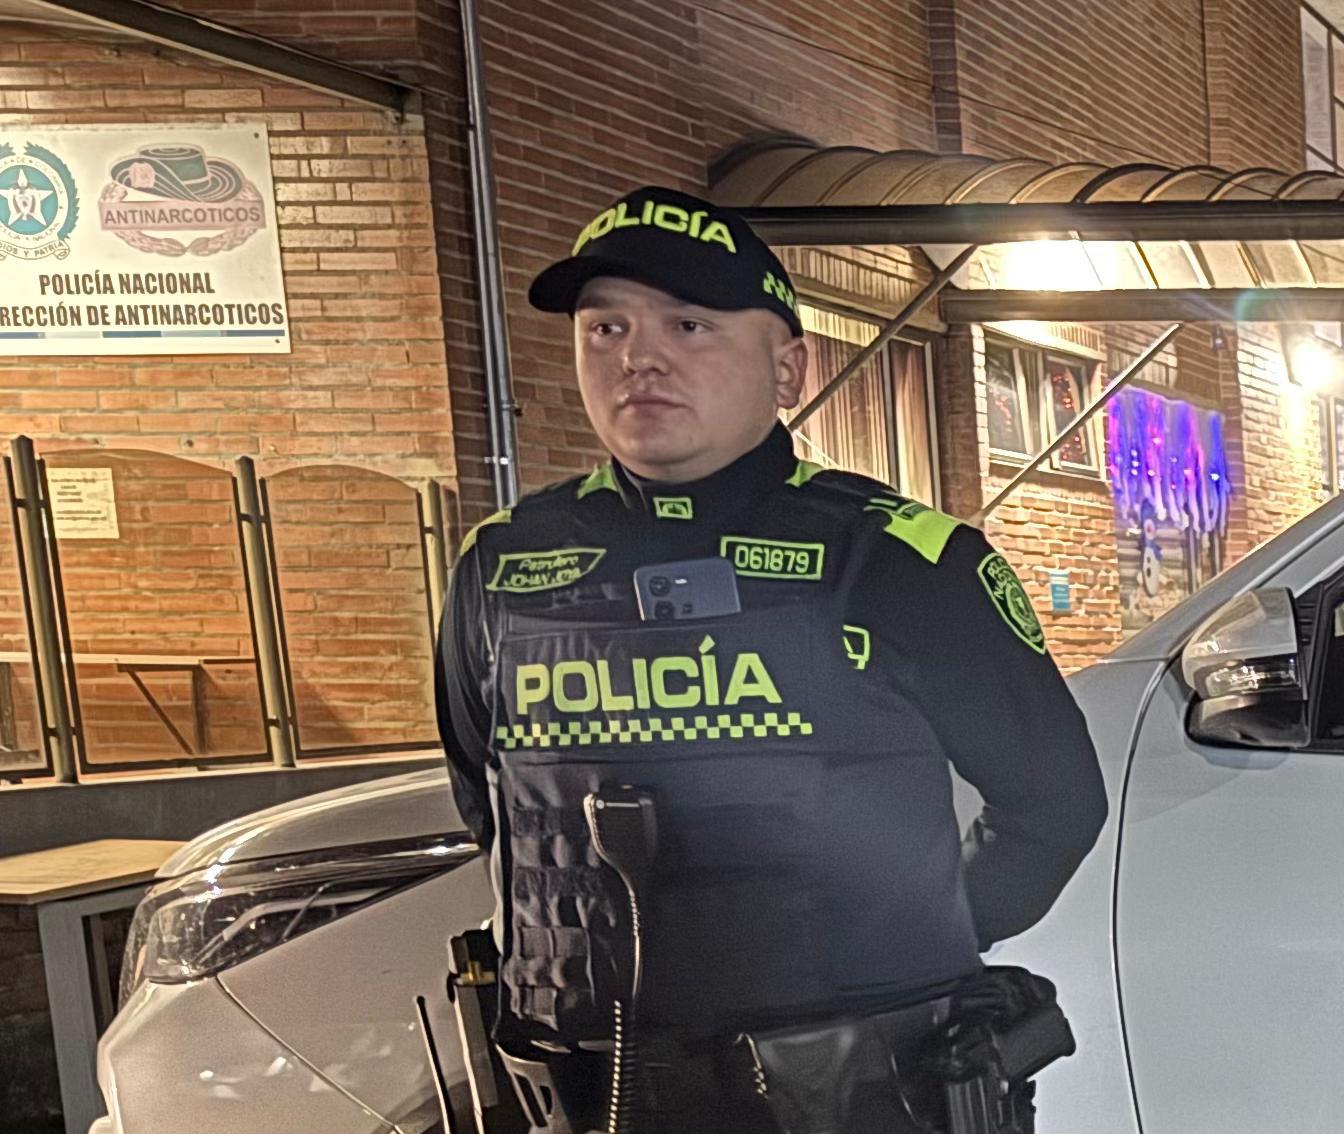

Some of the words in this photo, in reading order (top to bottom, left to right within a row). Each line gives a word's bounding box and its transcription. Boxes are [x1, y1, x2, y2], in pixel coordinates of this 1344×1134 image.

[104, 206, 262, 226] ANTINARCOTICOS
[34, 241, 65, 257] PATRIA
[39, 270, 115, 295] POLICÍA
[119, 272, 215, 294] NACIONAL
[87, 305, 111, 326] DE
[115, 302, 285, 326] ANTINARCOTICOS
[734, 545, 810, 574] 061879
[515, 635, 783, 715] POLICÍA
